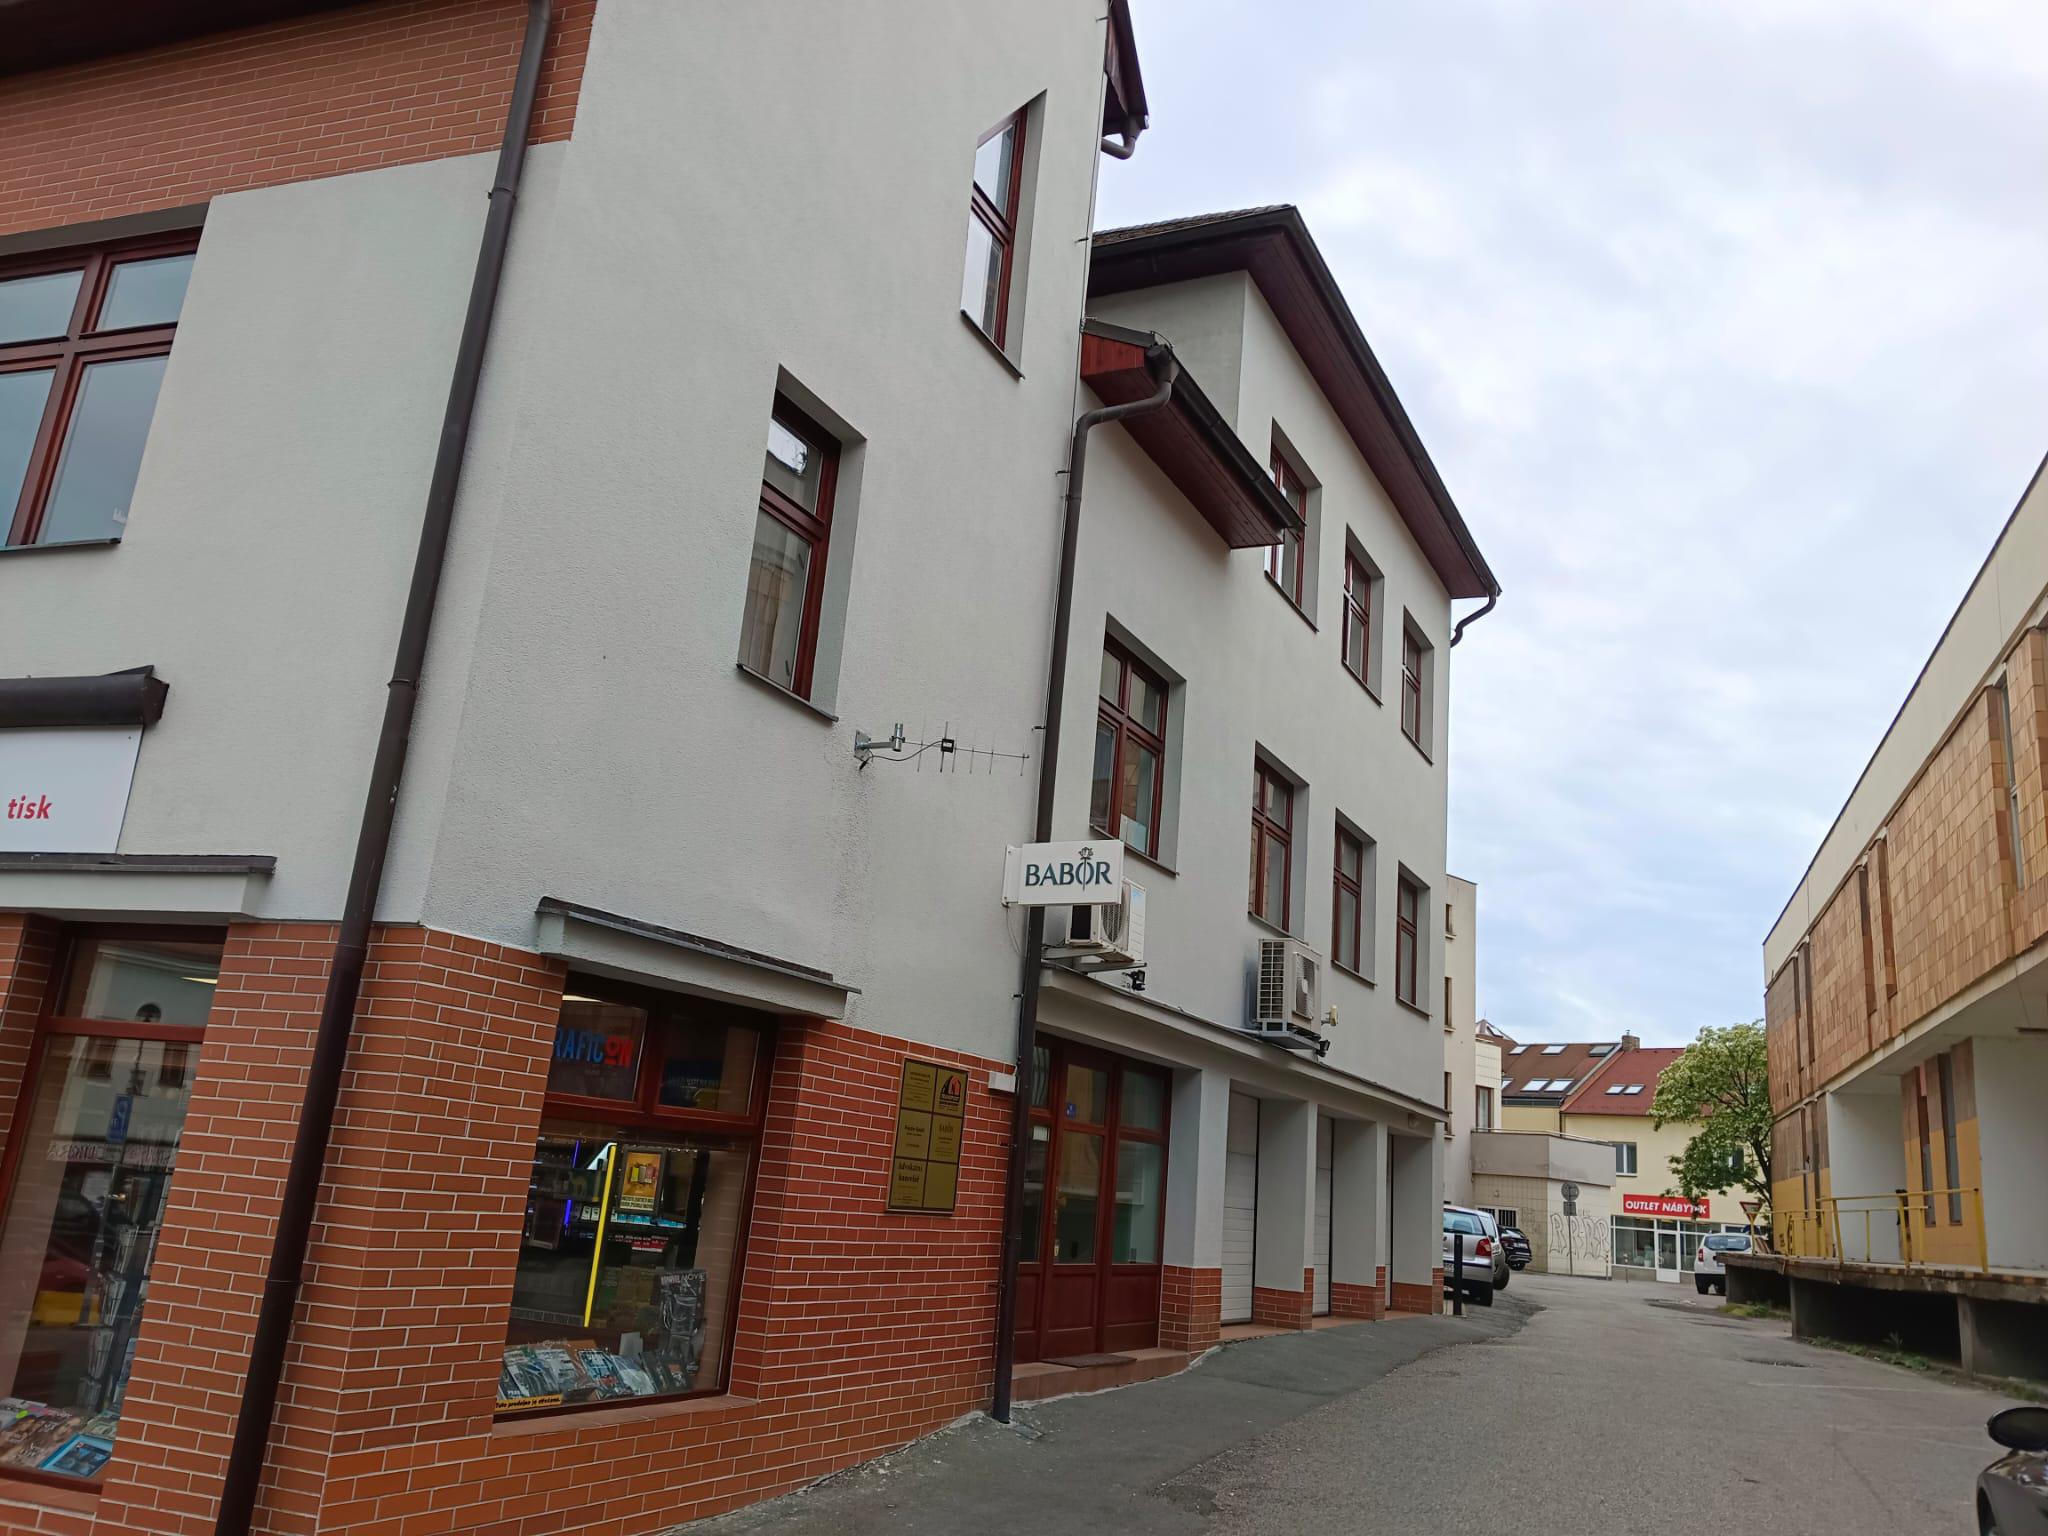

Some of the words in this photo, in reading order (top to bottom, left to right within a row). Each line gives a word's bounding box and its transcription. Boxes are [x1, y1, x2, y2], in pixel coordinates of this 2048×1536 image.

[7, 795, 53, 820] tisk
[1024, 860, 1113, 888] BABOR
[1625, 1200, 1660, 1211] OUTLET
[1662, 1201, 1707, 1214] NÁBYTK
